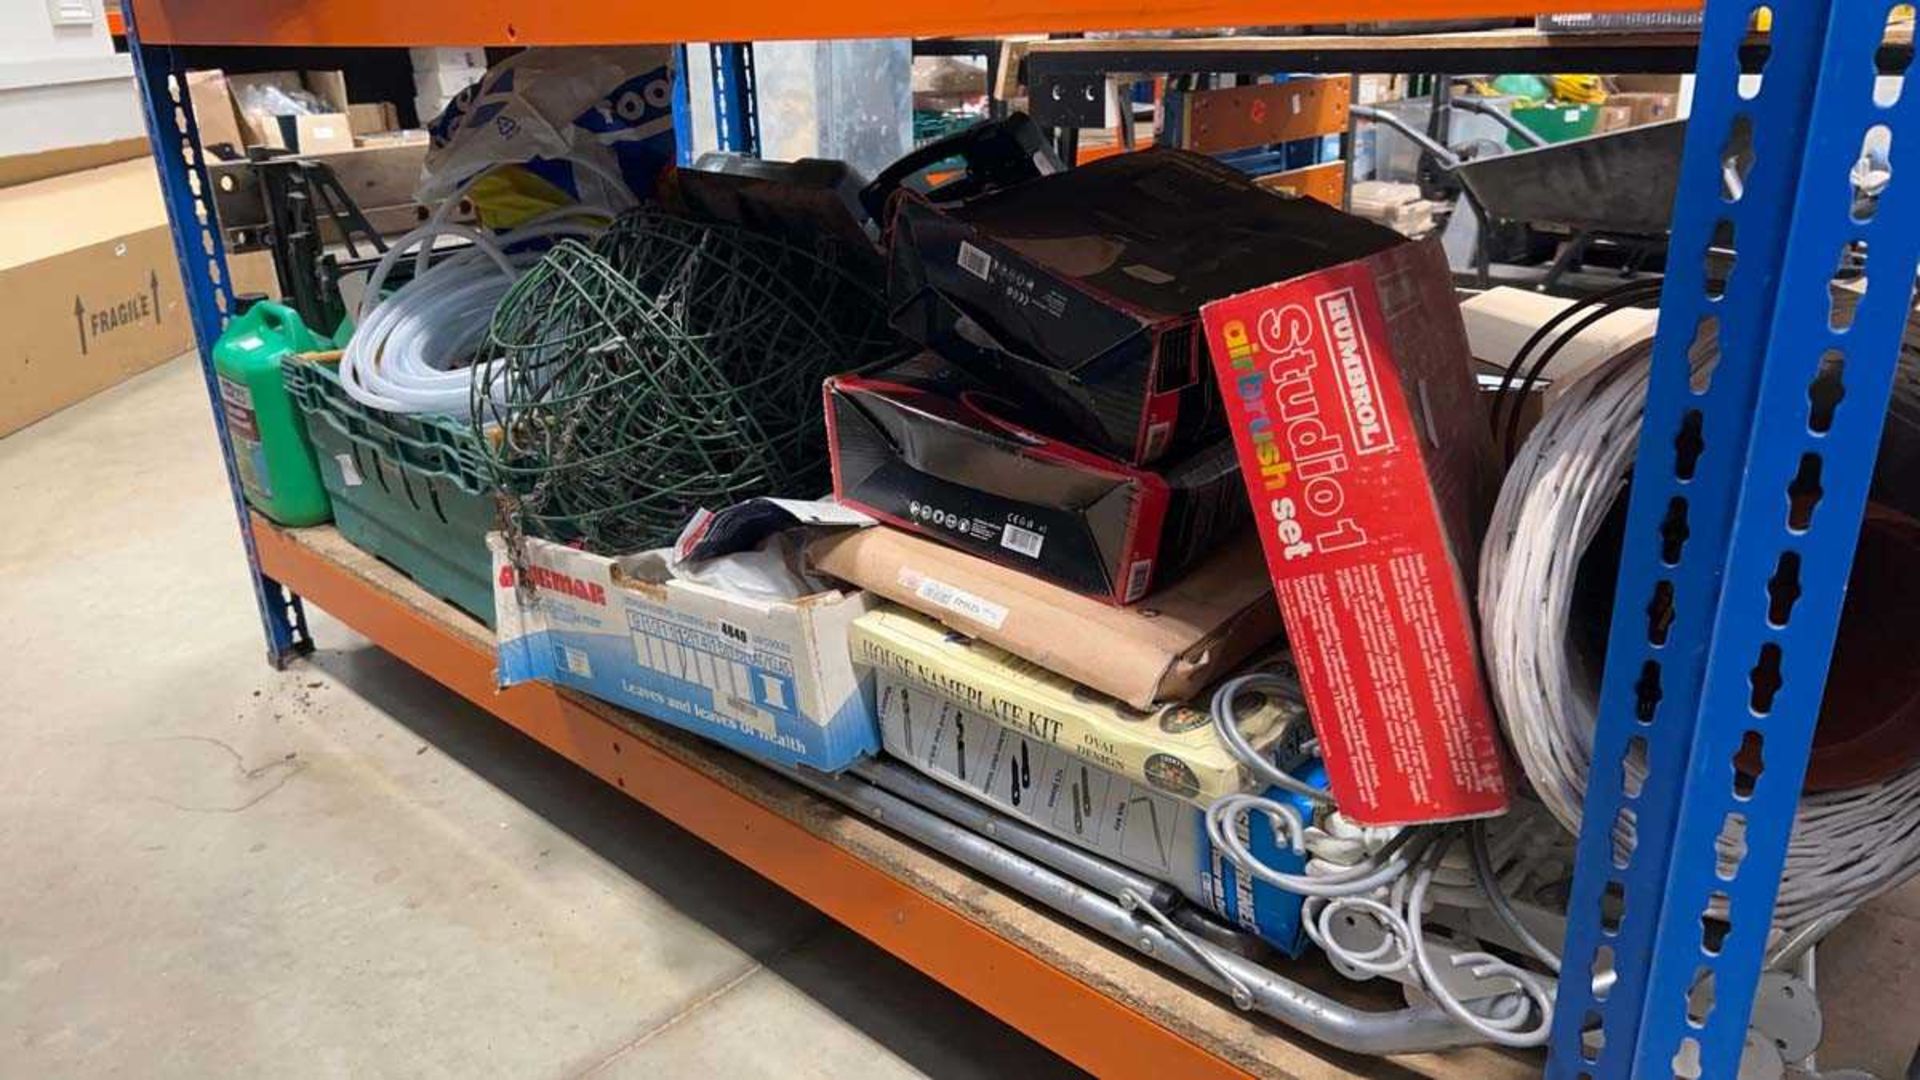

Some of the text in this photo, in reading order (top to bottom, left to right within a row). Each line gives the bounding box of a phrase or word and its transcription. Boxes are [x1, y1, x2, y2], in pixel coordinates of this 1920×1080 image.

[594, 72, 671, 125] TOO
[91, 295, 150, 336] FRAGILE
[1327, 297, 1382, 446] HUMBROL
[1257, 303, 1349, 517] Studio
[1270, 496, 1315, 561] set
[863, 639, 914, 678] HOUSE
[918, 665, 1025, 727] NAMEPLATE
[1028, 711, 1064, 743] KIT
[668, 697, 691, 716] and
[758, 727, 807, 755] health
[1084, 733, 1118, 756] OVAL
[1076, 744, 1125, 770] DESIGN
